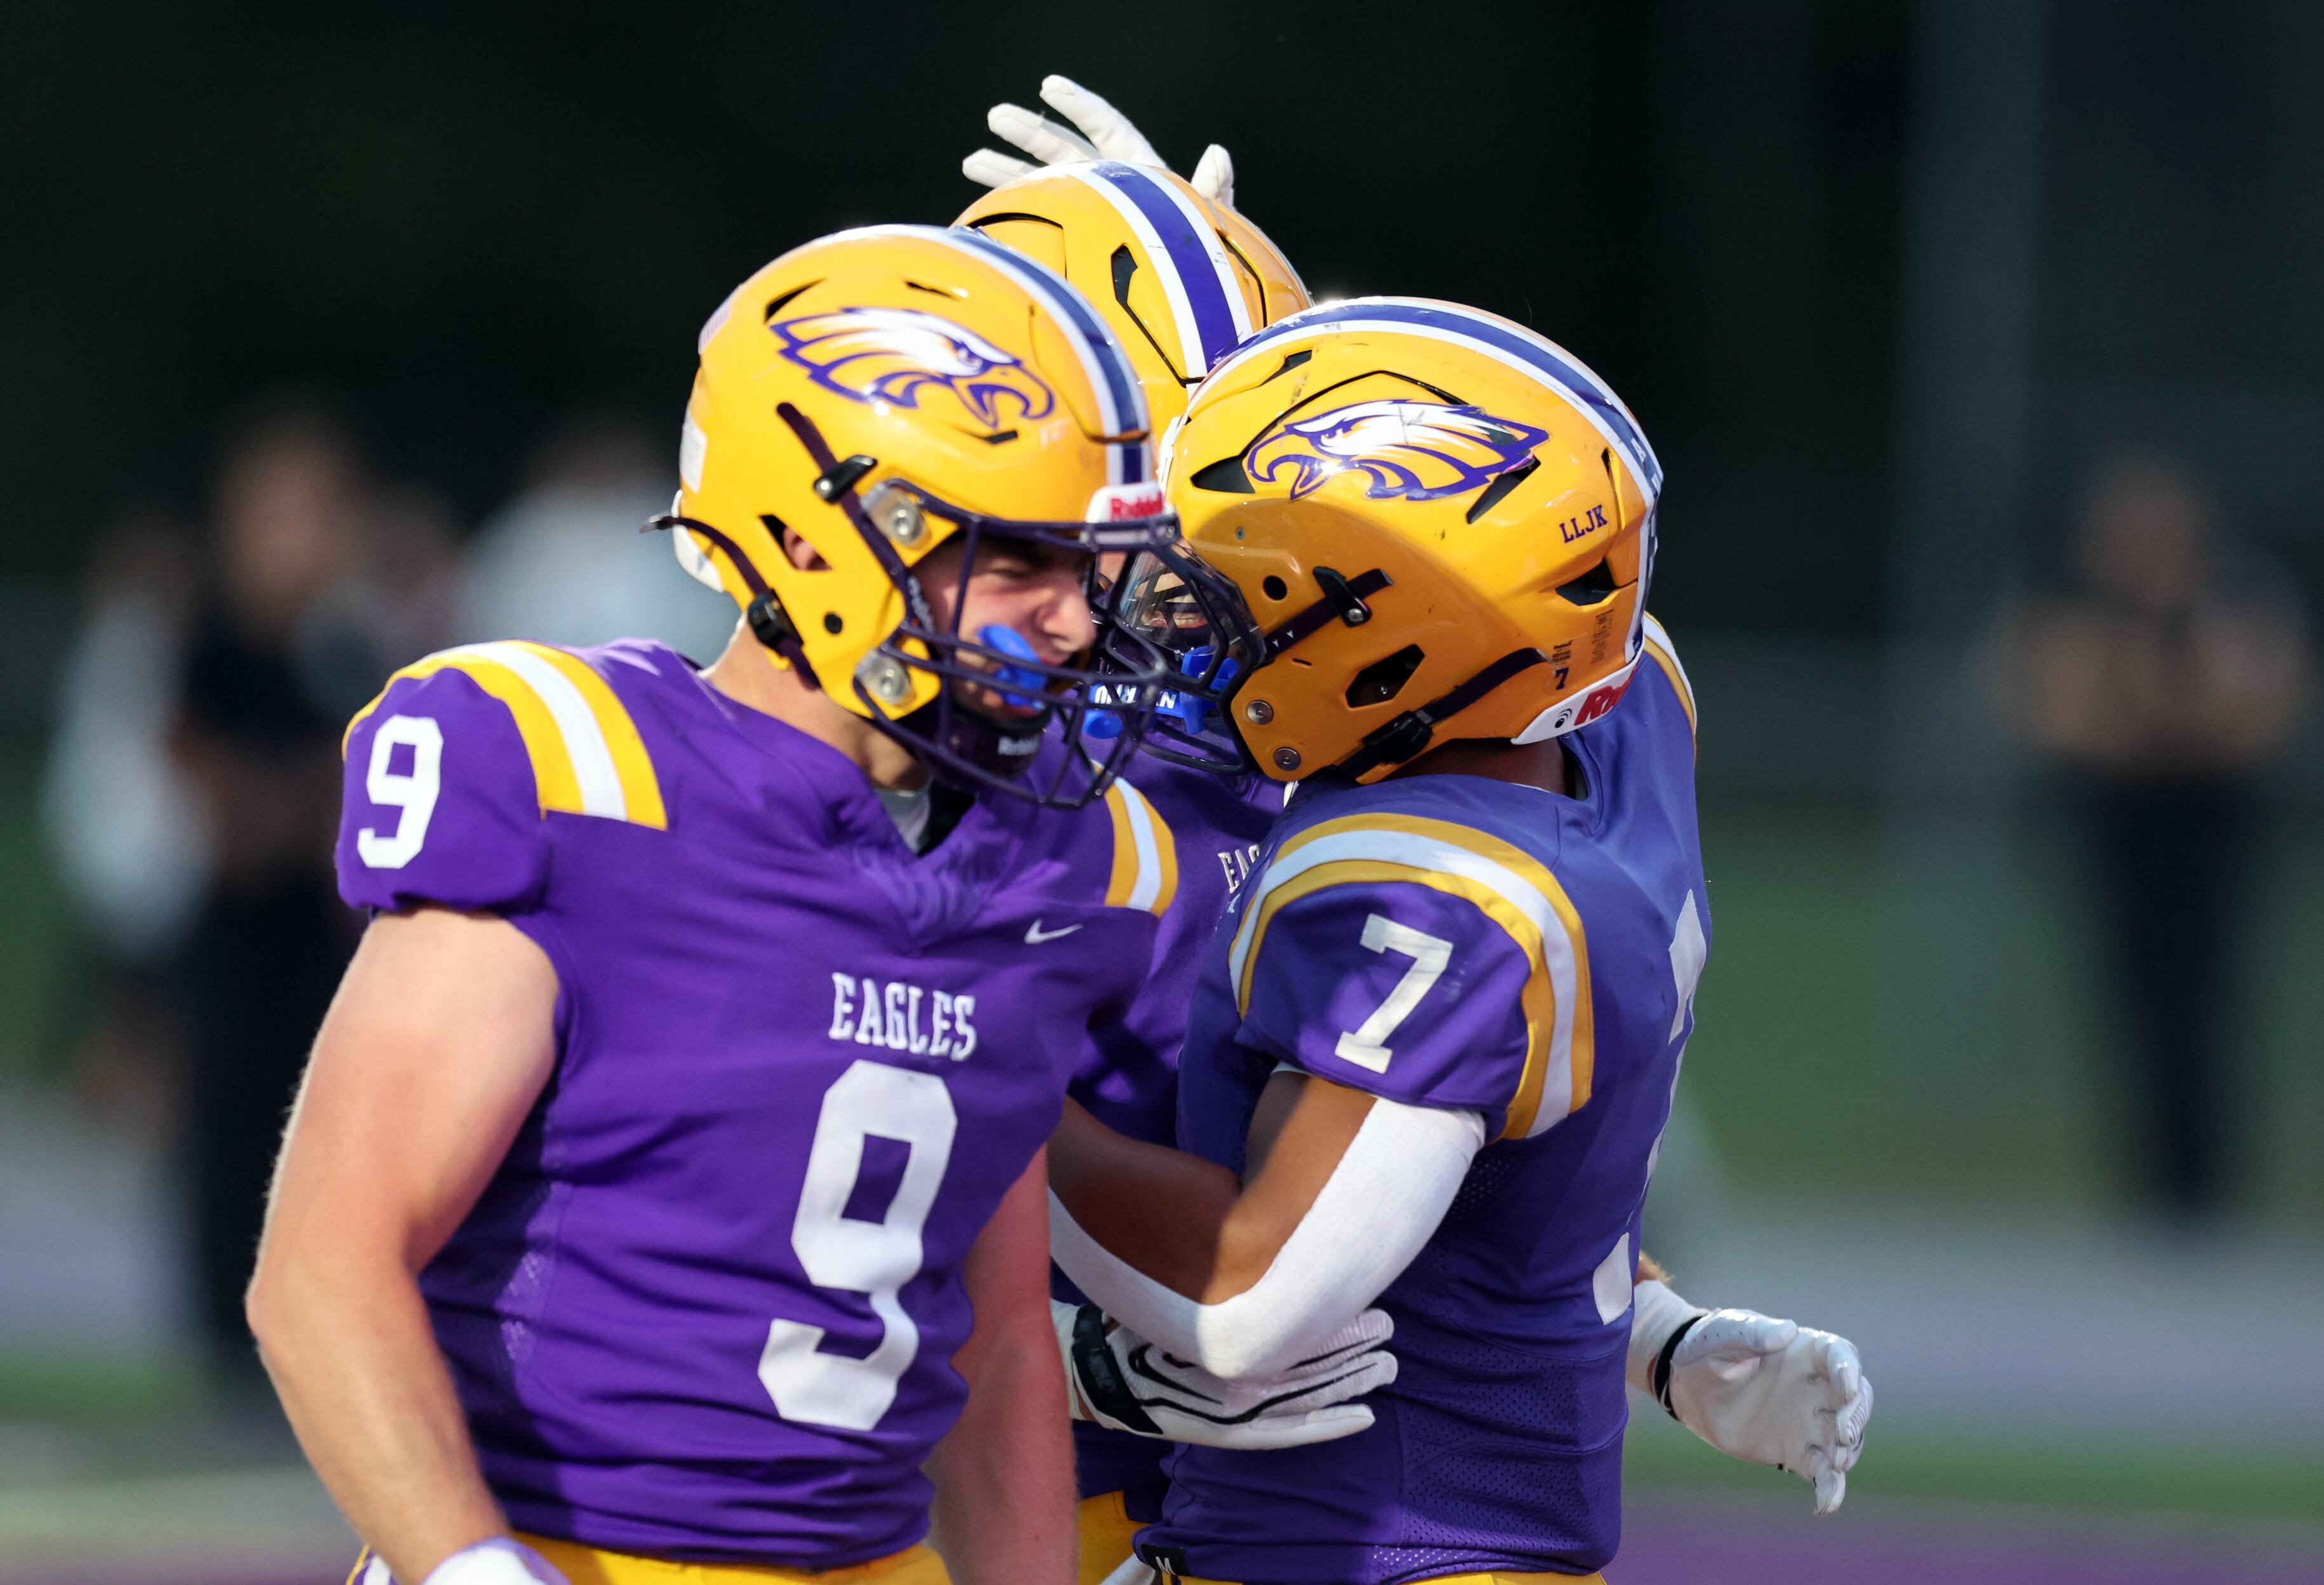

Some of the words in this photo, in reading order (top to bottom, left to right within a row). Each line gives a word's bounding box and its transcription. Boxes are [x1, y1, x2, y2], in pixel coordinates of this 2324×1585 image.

[1559, 504, 1608, 543] LLJK
[1554, 667, 1569, 691] 7
[357, 713, 445, 870] 9
[828, 972, 978, 1062] EAGLES
[1334, 913, 1454, 1075] 7
[757, 1059, 958, 1431] 9
